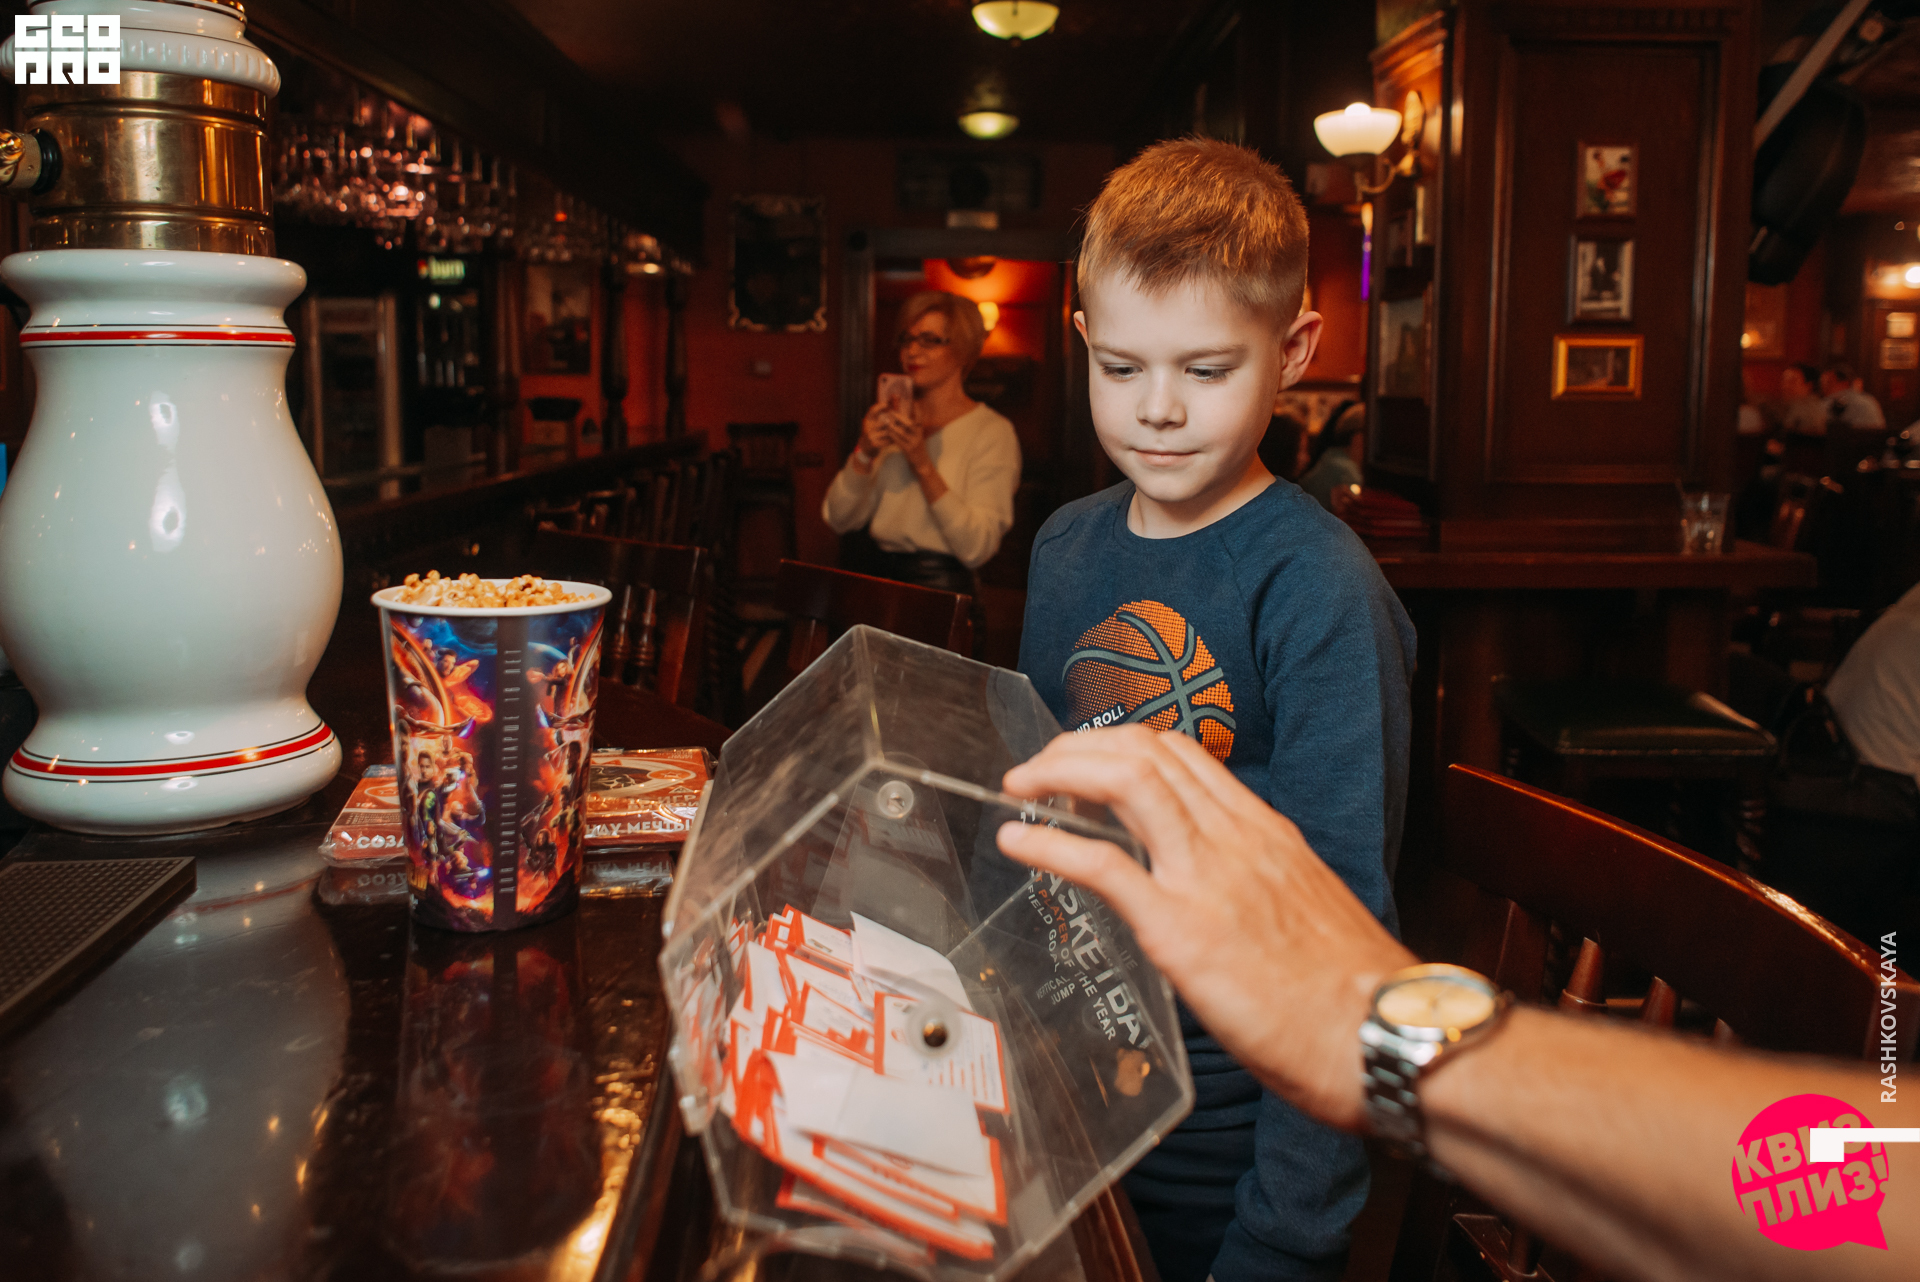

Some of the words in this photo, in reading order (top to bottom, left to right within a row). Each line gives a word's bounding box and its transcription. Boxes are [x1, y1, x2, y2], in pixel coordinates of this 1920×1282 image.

[503, 649, 522, 674] ЛЕТ
[1092, 705, 1125, 729] ROLL
[502, 715, 520, 770] СТАРШЕ
[1027, 884, 1053, 925] FIELD
[1048, 928, 1060, 973] GOAL
[1038, 889, 1068, 944] PLAYER
[1060, 947, 1075, 968] OF
[1074, 969, 1098, 997] THE
[1092, 996, 1117, 1041] YEAR
[1035, 975, 1071, 1000] VERTICAL
[1051, 982, 1076, 1005] JUMP
